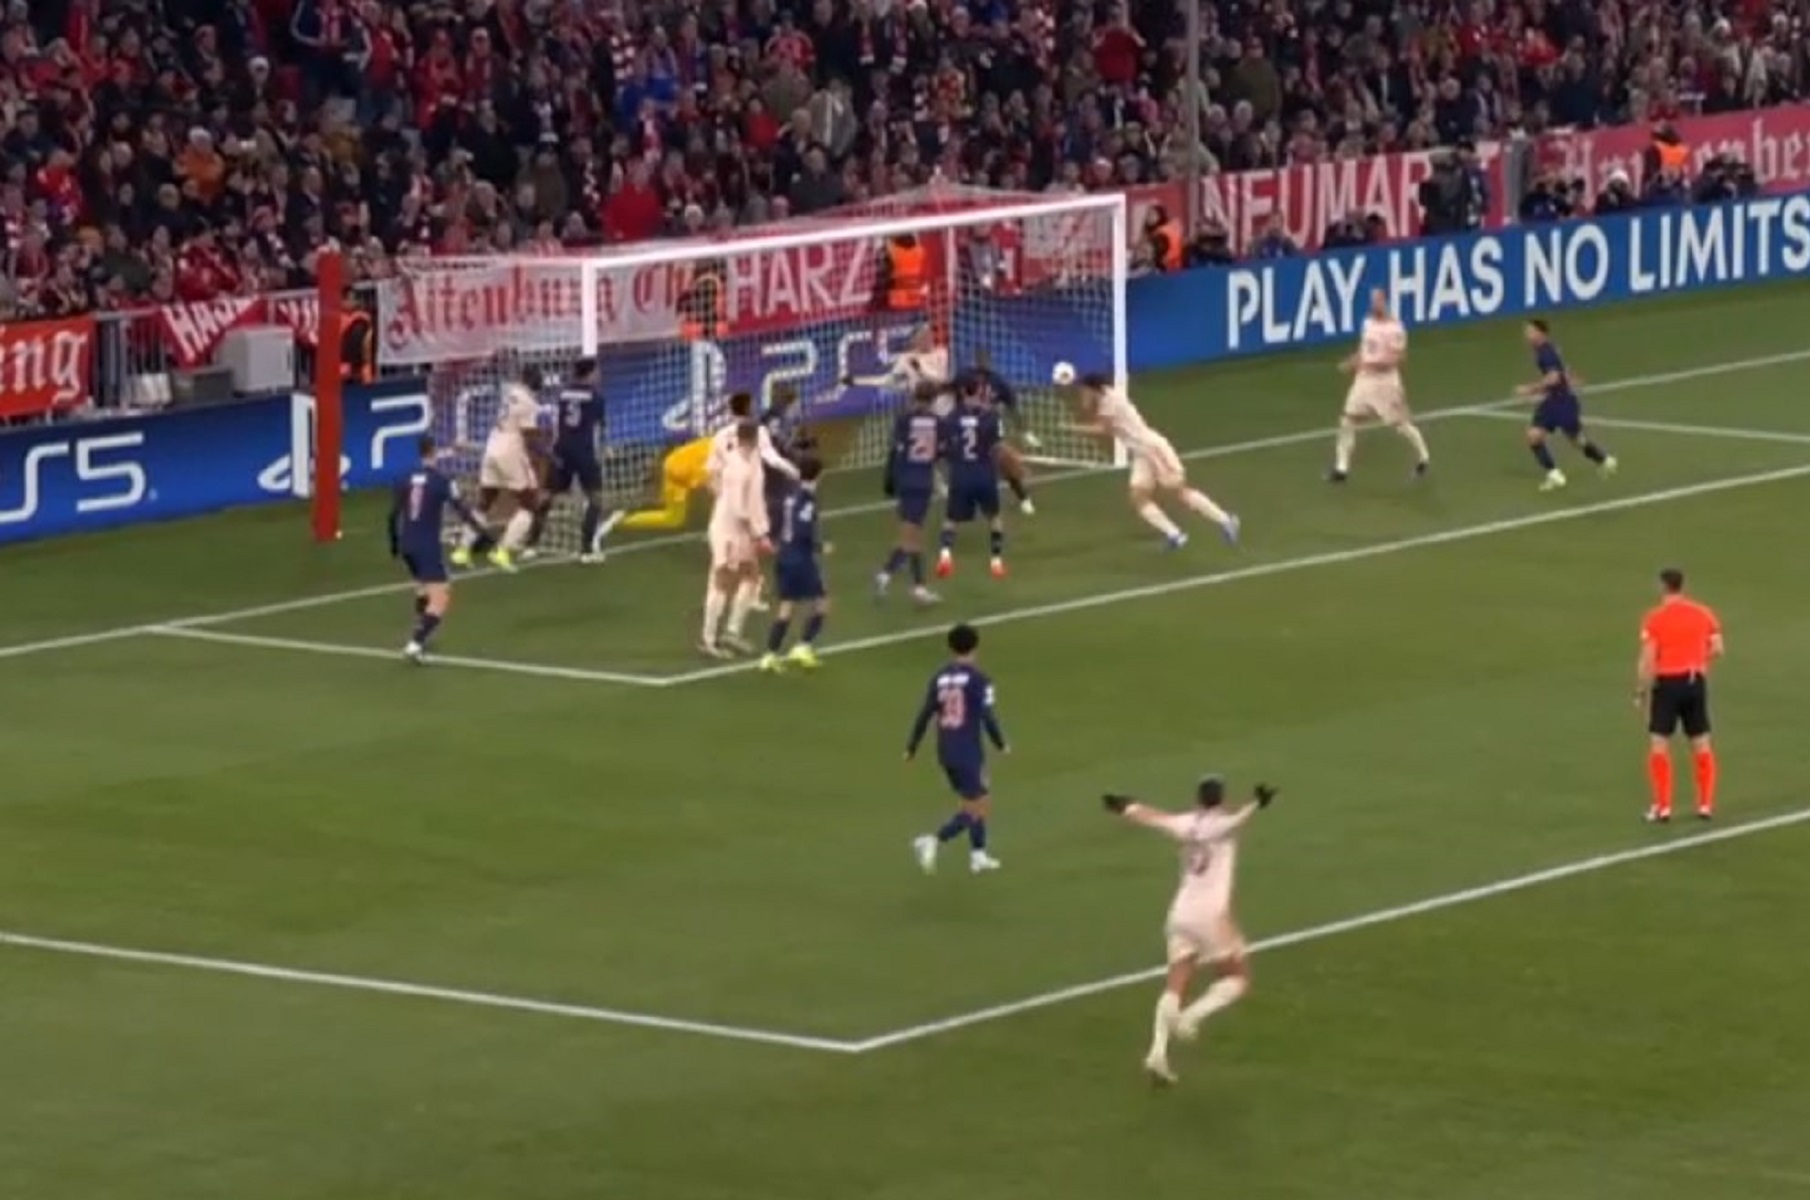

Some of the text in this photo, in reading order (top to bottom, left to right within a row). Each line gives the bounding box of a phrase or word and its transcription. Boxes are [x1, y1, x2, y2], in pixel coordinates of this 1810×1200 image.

[1228, 194, 1810, 349] PLAY HAS NO LIMITS
